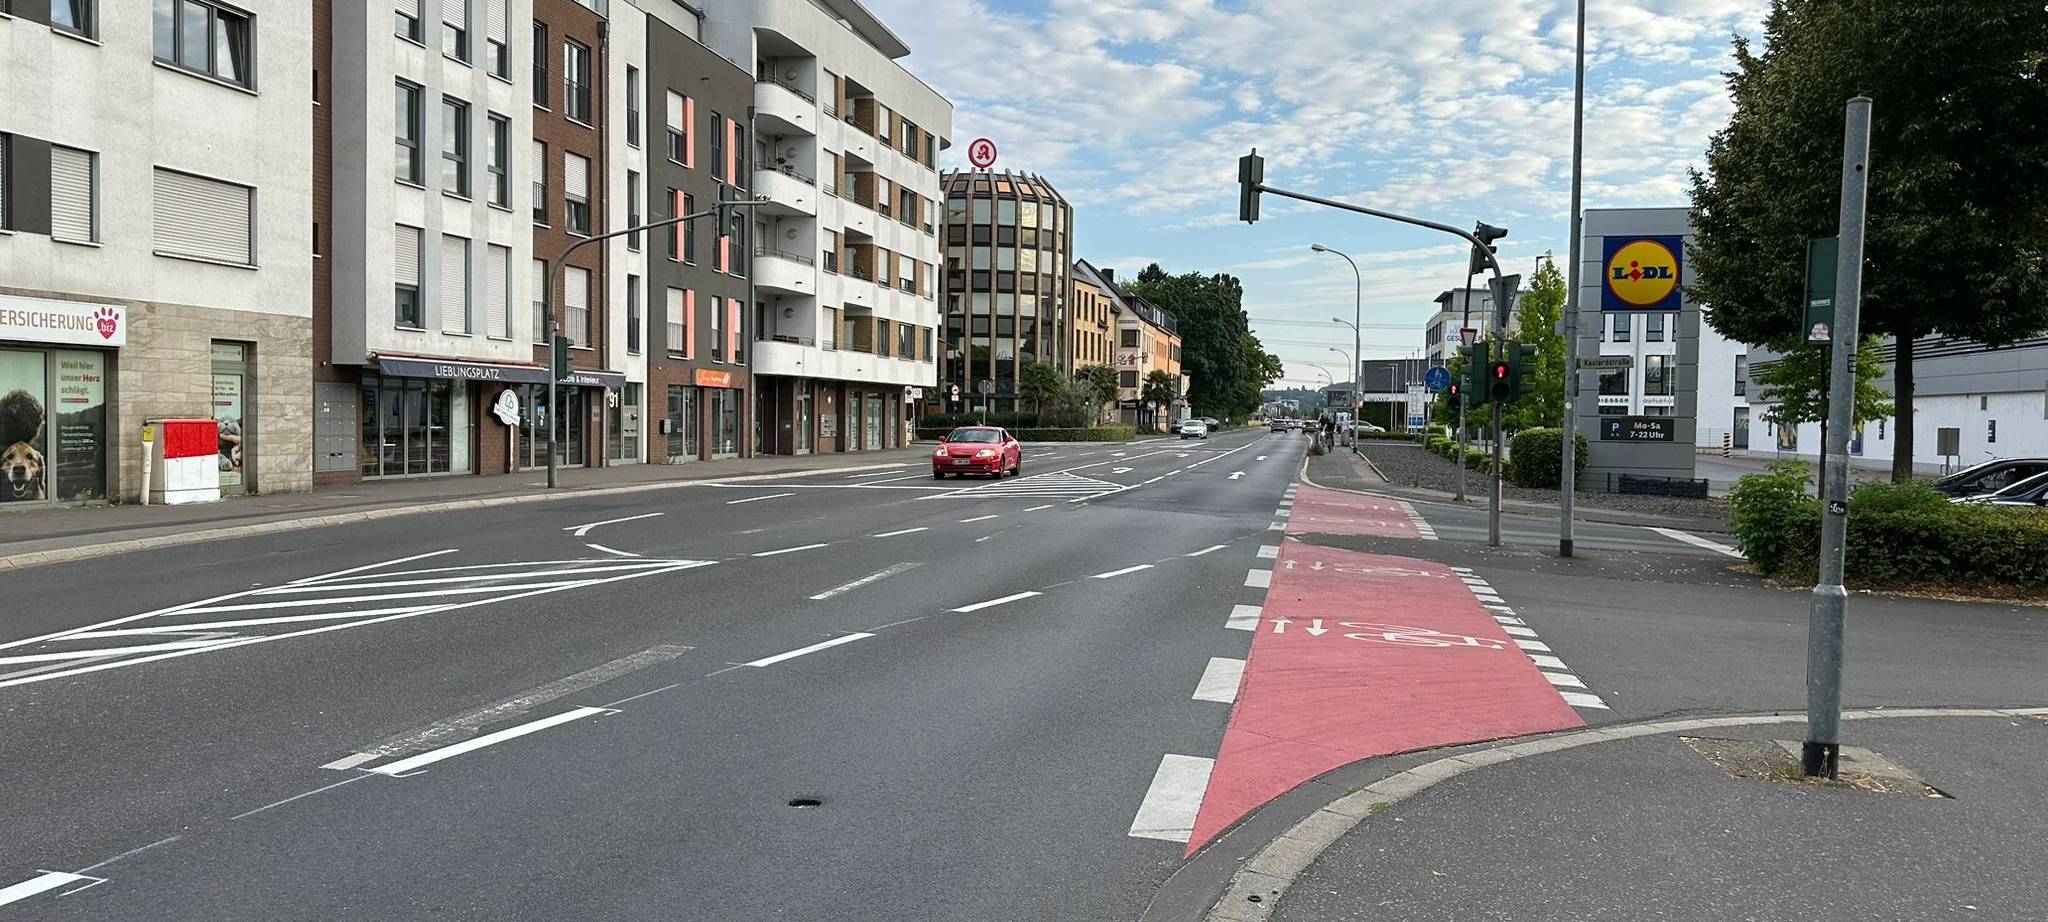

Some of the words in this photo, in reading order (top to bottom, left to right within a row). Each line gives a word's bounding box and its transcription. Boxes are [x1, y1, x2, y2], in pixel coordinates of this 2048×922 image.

[0, 309, 94, 331] ERSICHERUNG
[101, 321, 114, 333] biz
[61, 360, 79, 369] Weil
[79, 361, 94, 370] hier
[82, 374, 100, 382] Herz
[435, 365, 500, 379] LIEBLINGSPLATZ
[609, 391, 619, 408] 91
